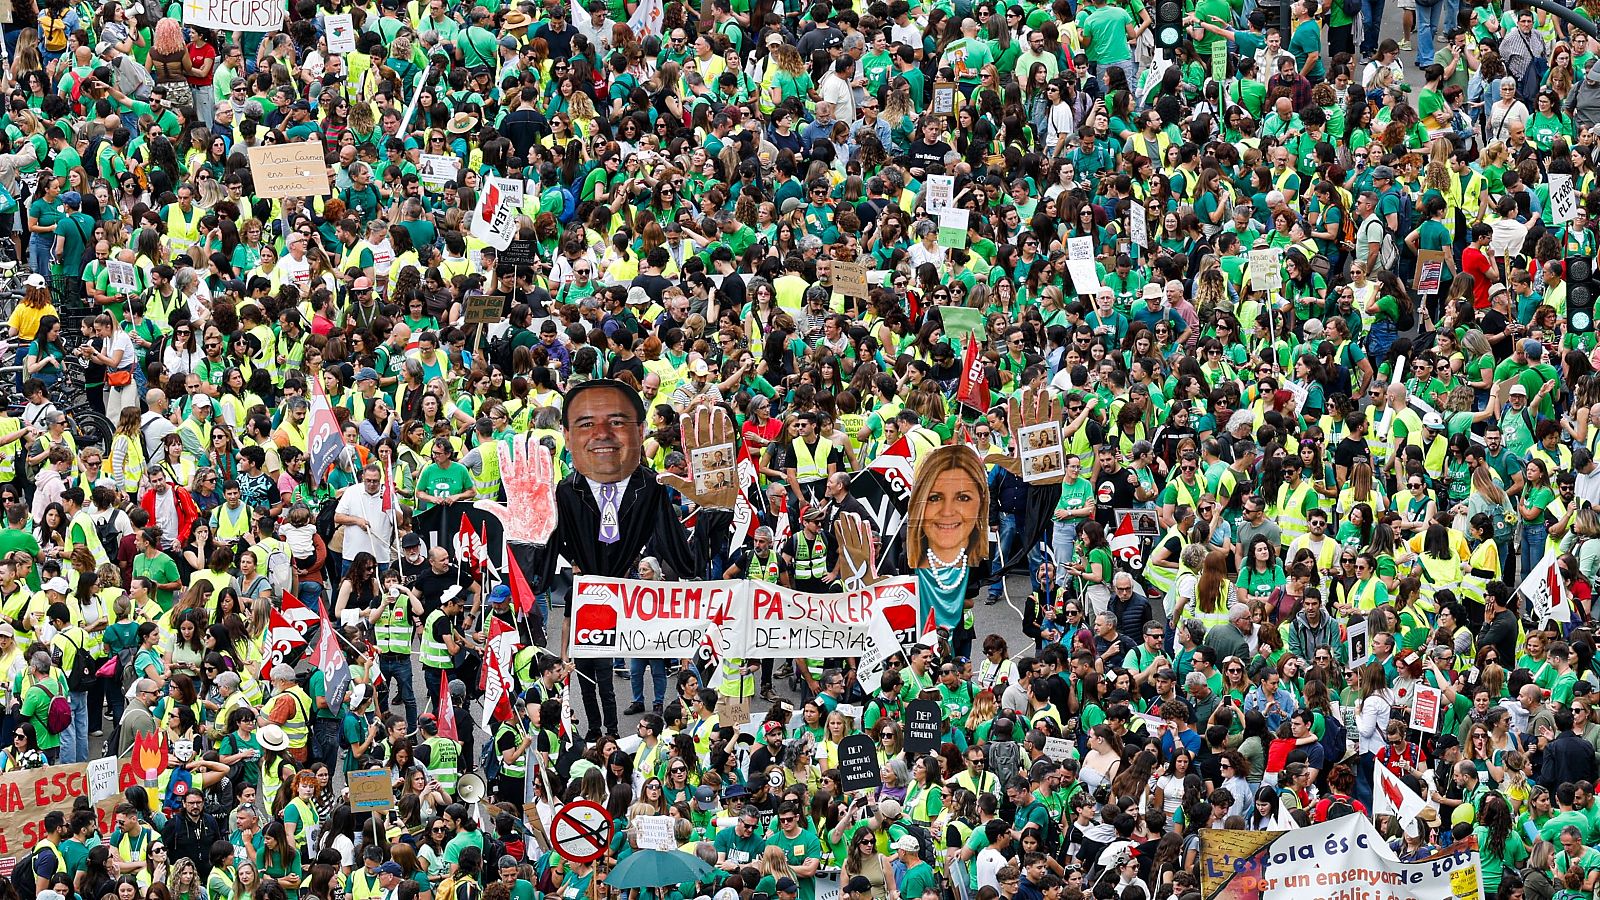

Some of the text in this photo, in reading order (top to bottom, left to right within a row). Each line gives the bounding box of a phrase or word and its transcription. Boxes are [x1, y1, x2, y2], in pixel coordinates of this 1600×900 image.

[208, 0, 282, 26] RECURSOS
[261, 151, 324, 165] Mari Carmen
[885, 467, 912, 501] CGT
[1120, 547, 1143, 570] CG
[577, 628, 616, 645] CGT
[652, 627, 732, 652] ACORS
[893, 627, 917, 645] GT
[731, 706, 742, 714] ARA
[738, 711, 749, 720] MAI
[916, 710, 931, 720] DEP
[848, 745, 863, 755] DEP
[35, 763, 137, 806] ESCA
[1325, 833, 1349, 855] és
[1432, 848, 1471, 878] tots
[1241, 876, 1278, 893] Per
[1284, 873, 1310, 888] un
